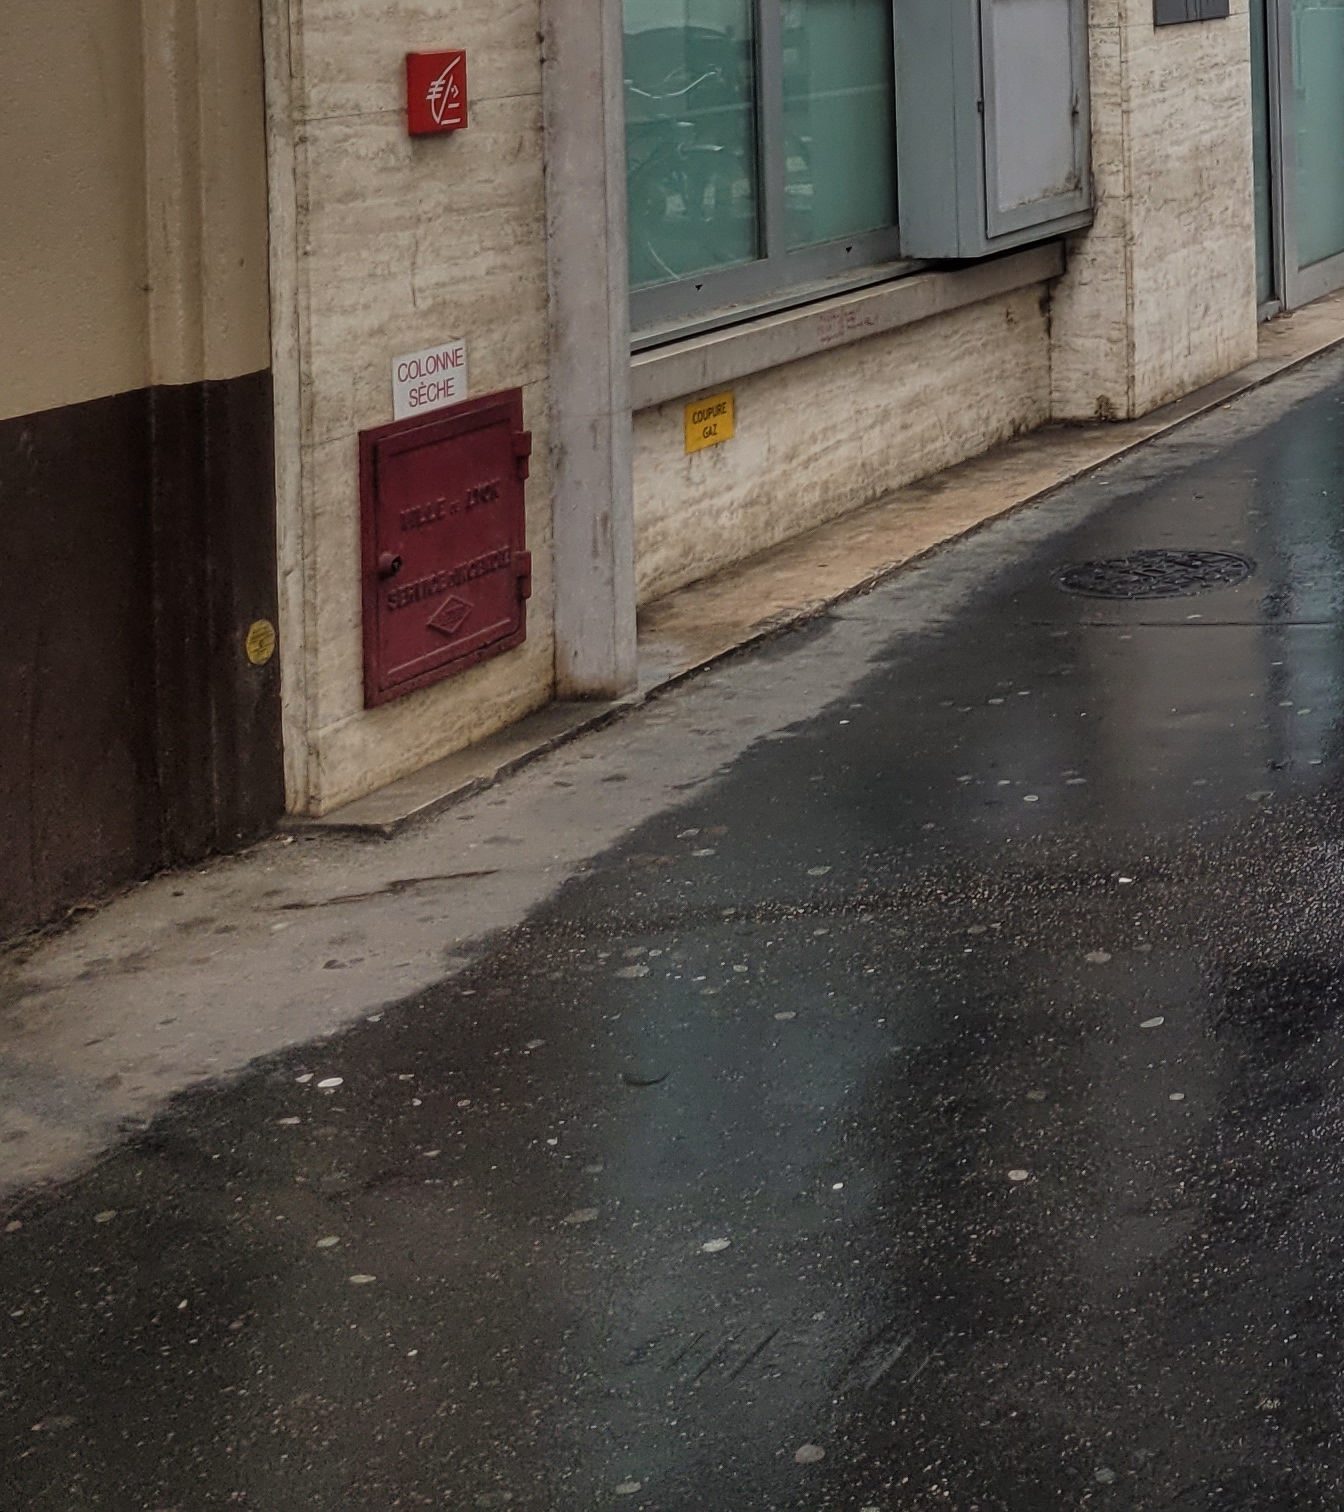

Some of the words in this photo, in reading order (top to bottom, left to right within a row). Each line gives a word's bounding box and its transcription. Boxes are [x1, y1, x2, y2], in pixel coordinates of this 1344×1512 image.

[397, 347, 465, 383] COLONNE
[408, 377, 456, 408] SÈCHE
[692, 401, 728, 425] COUPURE
[702, 423, 718, 439] GAZ
